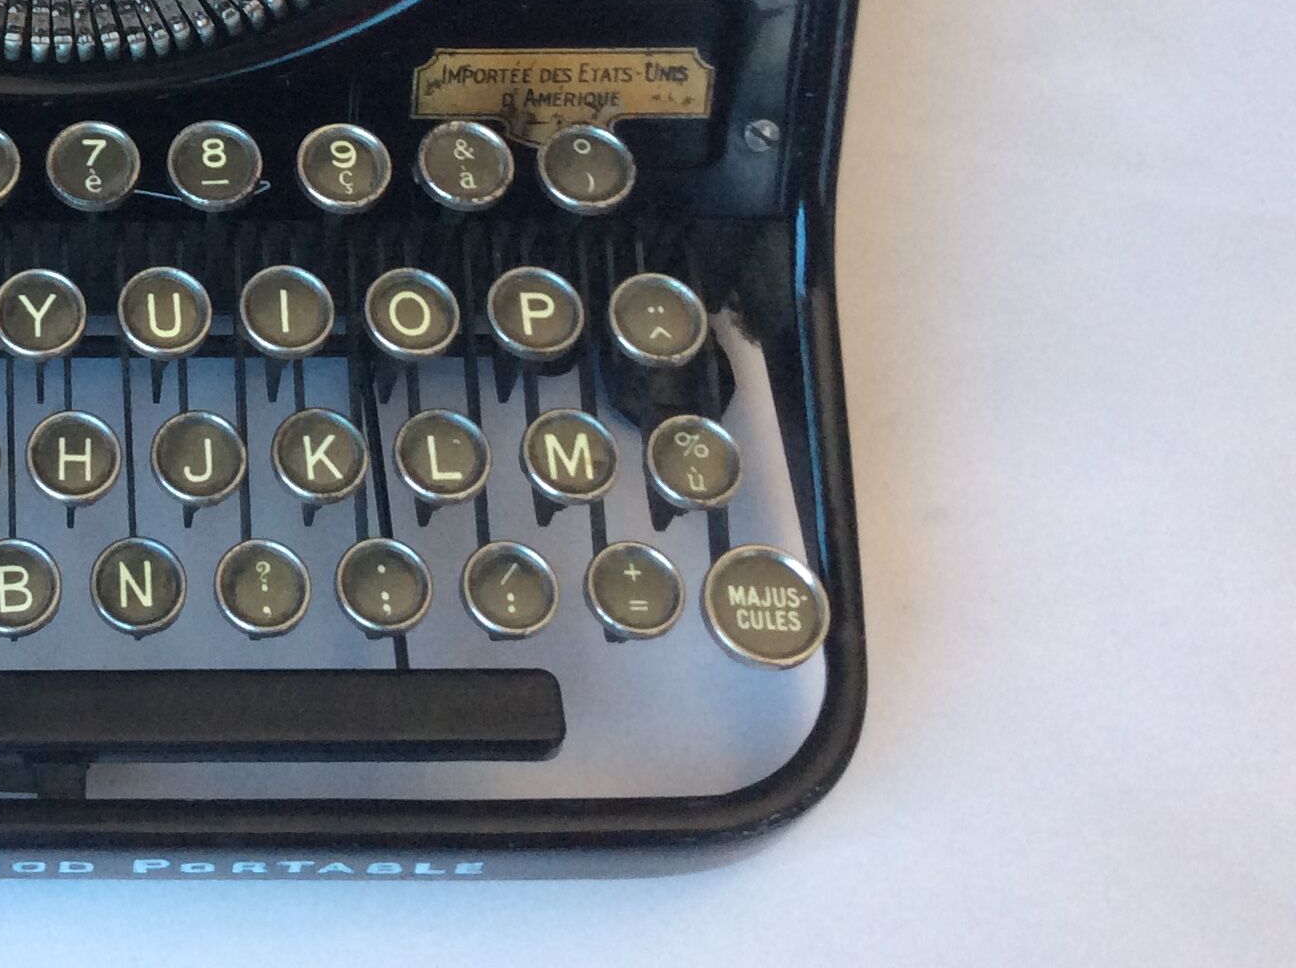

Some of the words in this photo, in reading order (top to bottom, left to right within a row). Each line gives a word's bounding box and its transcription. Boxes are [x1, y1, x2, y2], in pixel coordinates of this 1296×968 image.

[539, 67, 573, 83] DES
[82, 139, 107, 167] 7
[201, 138, 227, 168] 8
[330, 140, 357, 169] 9
[453, 138, 475, 161] &
[85, 168, 103, 193] è
[339, 170, 354, 195] ç
[459, 165, 477, 190] à
[18, 293, 57, 338] Y
[147, 292, 182, 338] U
[280, 289, 289, 333] I
[388, 290, 431, 337] O
[519, 292, 555, 336] P
[58, 436, 91, 482] H
[183, 438, 213, 483] J
[303, 434, 344, 481] K
[426, 435, 463, 480] L
[544, 433, 594, 480] M
[674, 431, 710, 459] %
[118, 560, 153, 608] N
[735, 608, 802, 632] CULES
[132, 858, 484, 875] PORTABLE
